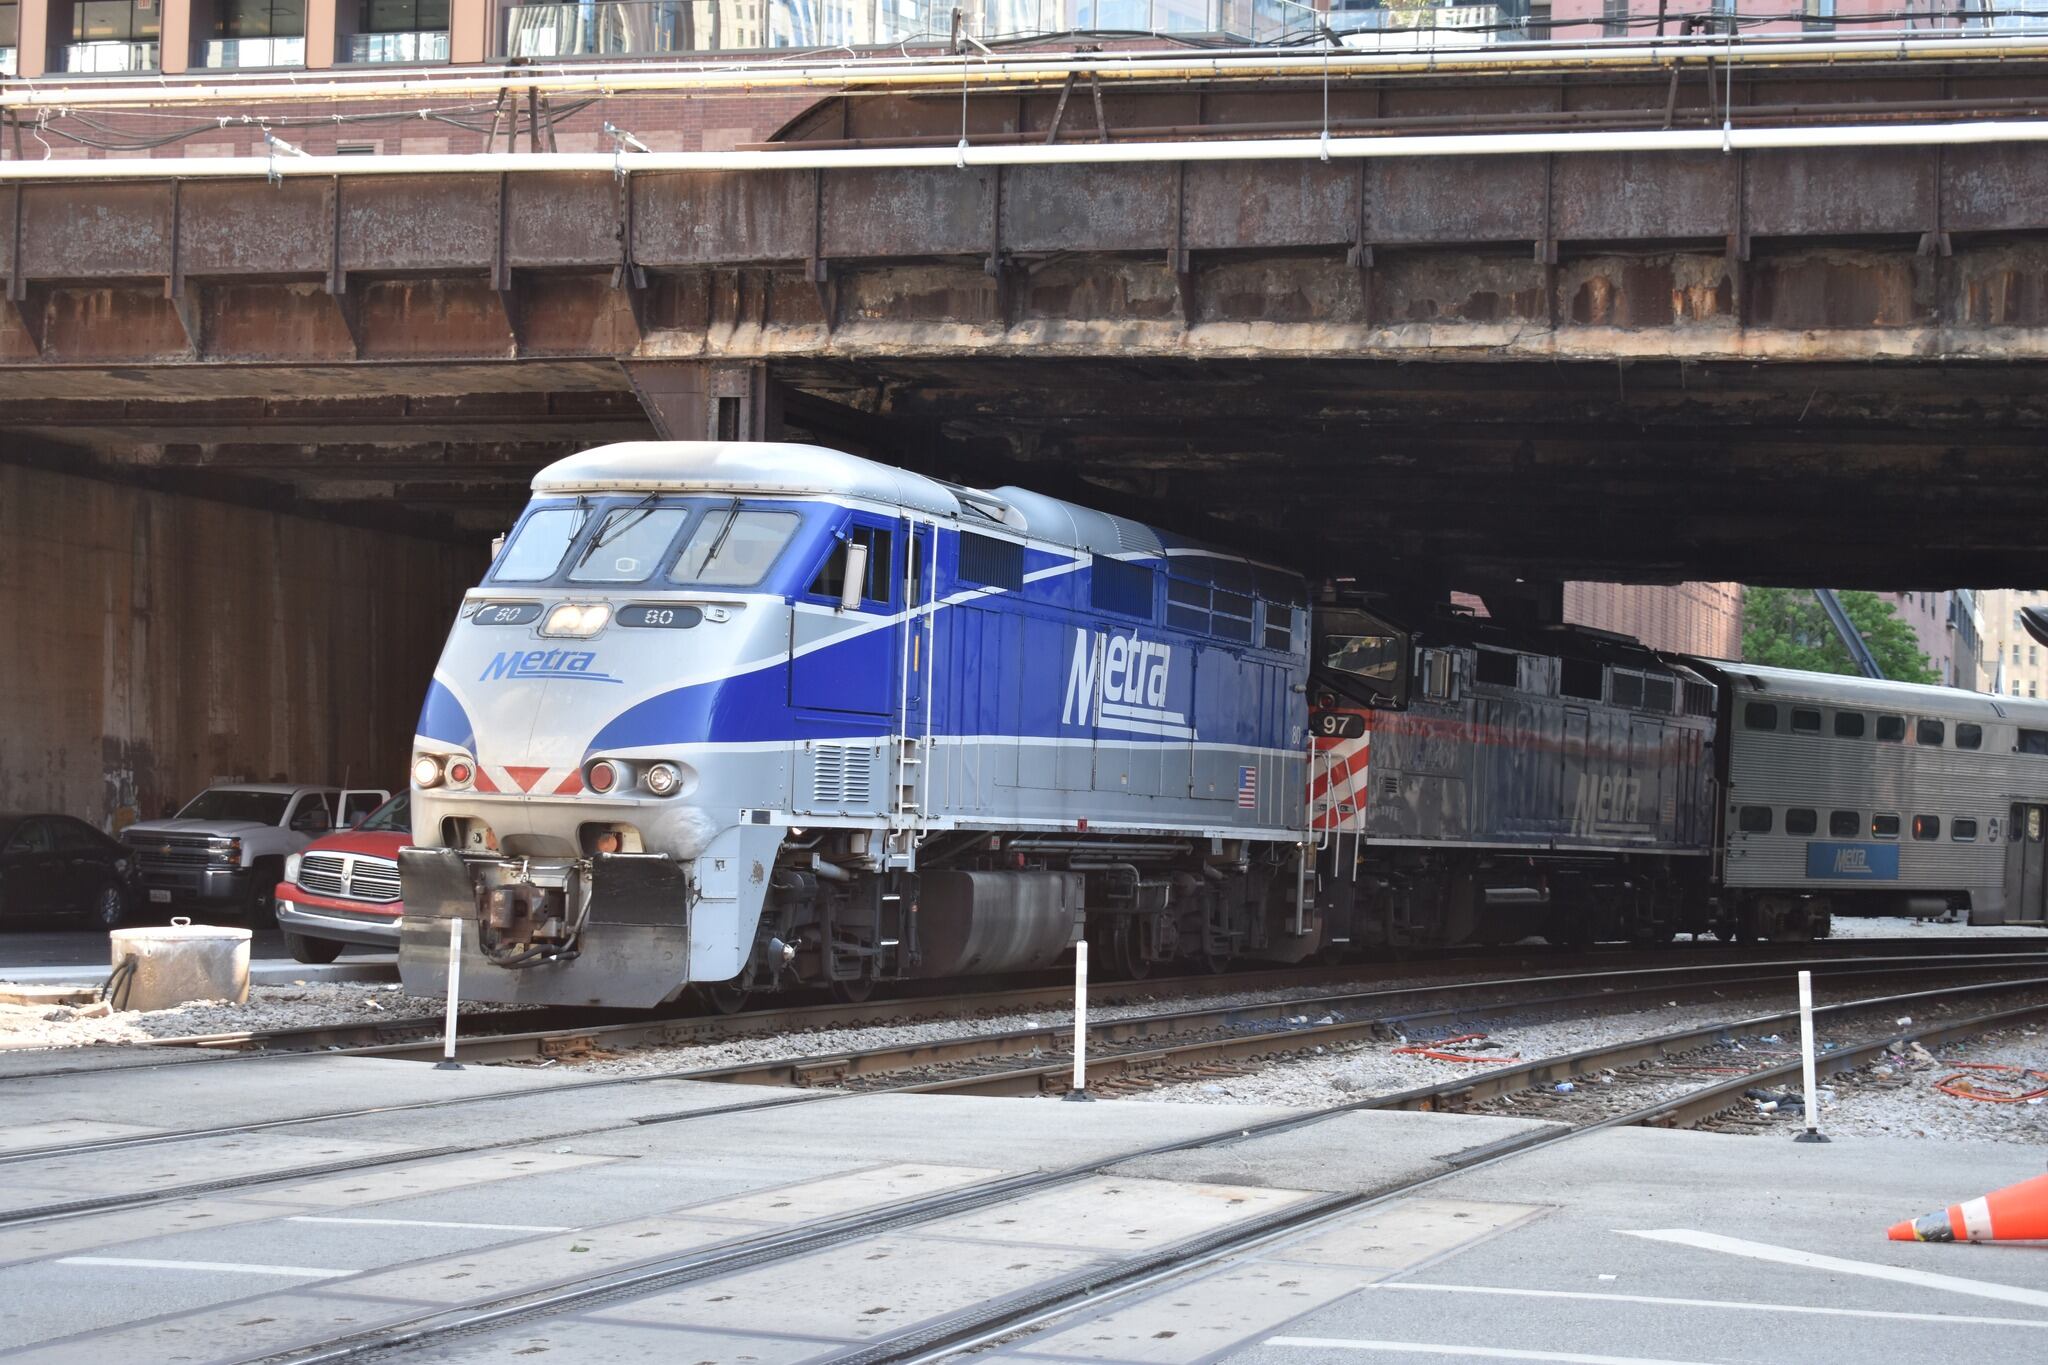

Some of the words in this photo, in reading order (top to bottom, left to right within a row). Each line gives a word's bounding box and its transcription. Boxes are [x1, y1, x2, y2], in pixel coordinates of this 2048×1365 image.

[494, 607, 521, 622] 80
[644, 609, 674, 625] 80
[478, 647, 597, 682] Metra
[1062, 628, 1171, 726] Metra
[1322, 715, 1350, 735] 97
[1571, 769, 1641, 837] Metra
[1833, 847, 1866, 873] Metra
